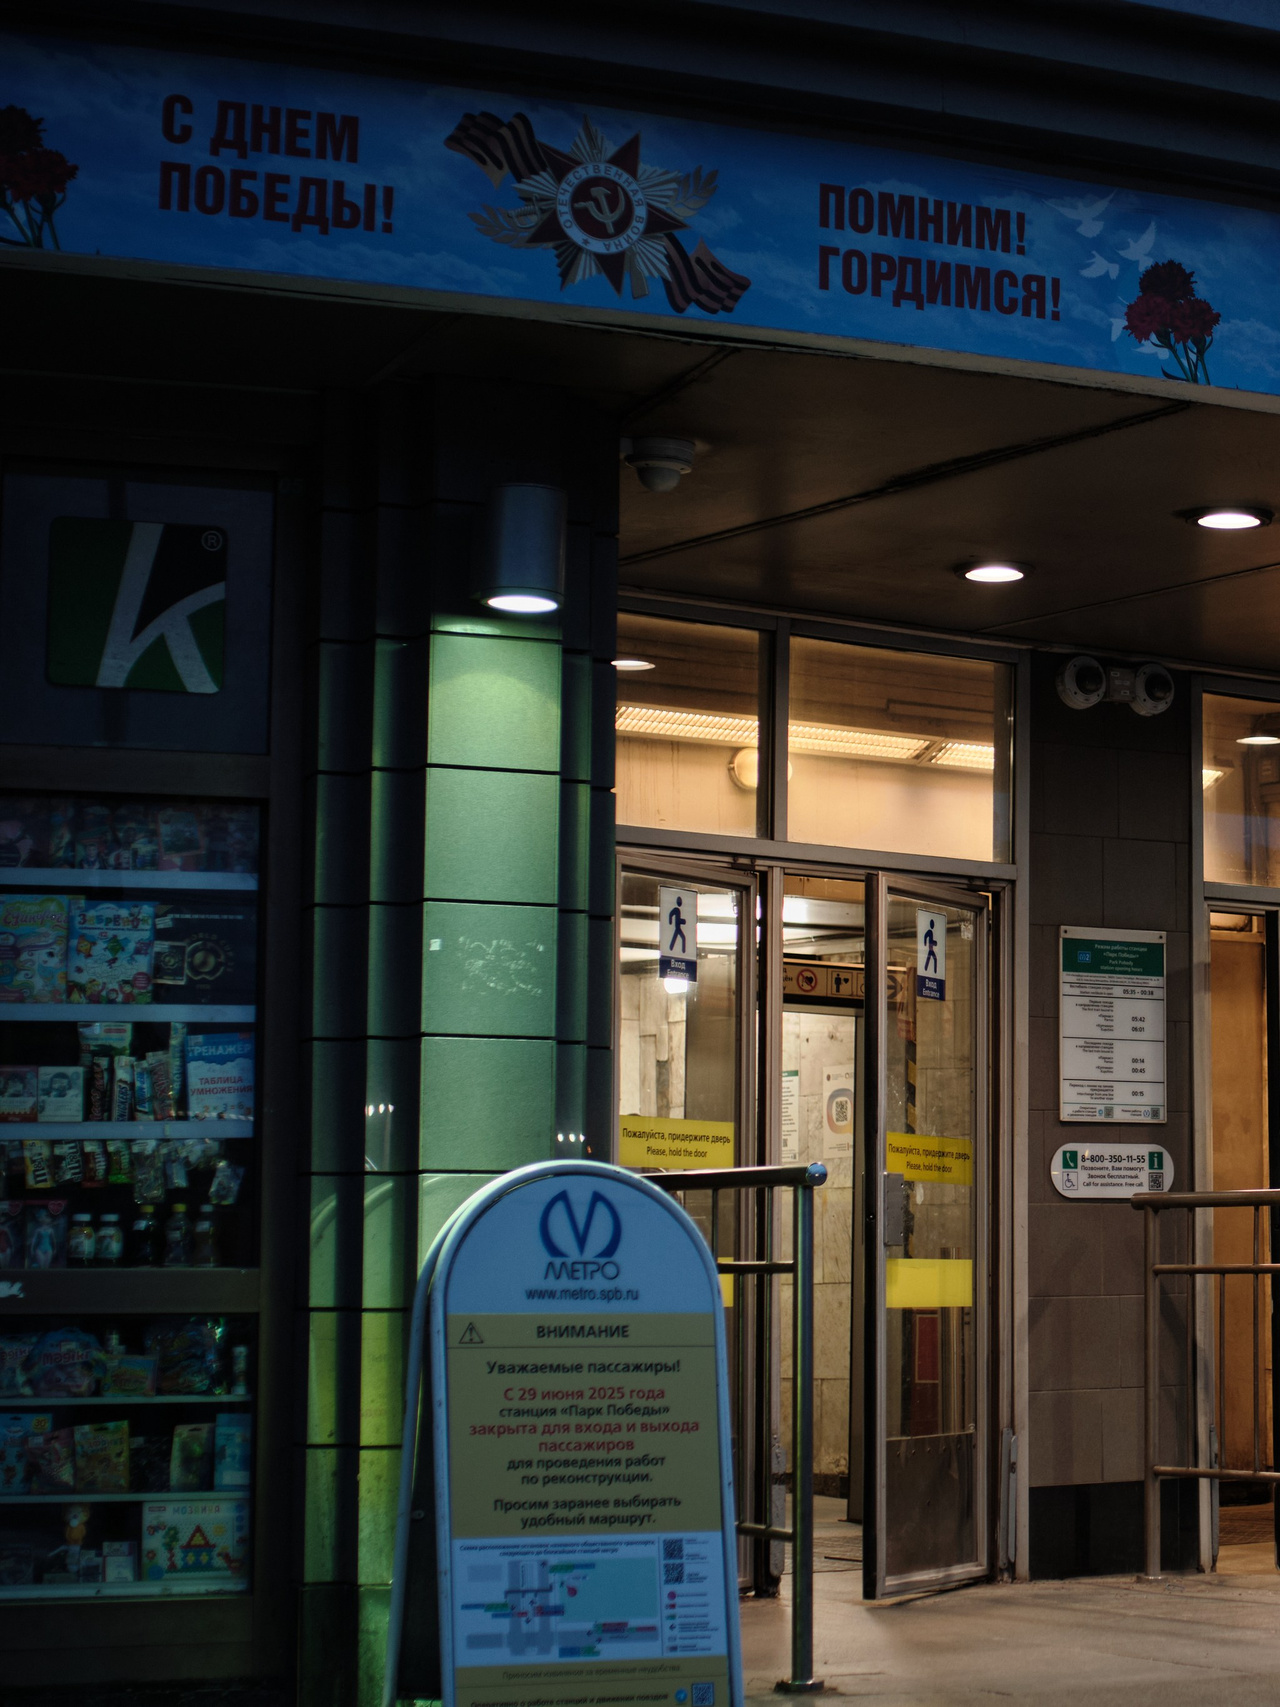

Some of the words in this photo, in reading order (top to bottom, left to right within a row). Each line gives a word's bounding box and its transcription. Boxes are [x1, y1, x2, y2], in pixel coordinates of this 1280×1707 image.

[161, 94, 192, 144] С
[210, 99, 360, 164] ДНЕМ
[159, 160, 395, 235] ПОБЕДЫ!
[558, 164, 644, 229] ОТЕЧЕСТВЕННАЯ
[818, 182, 1026, 256] ПОМНИМ!
[818, 245, 1061, 322] ГОРДИМСЯ!
[925, 979, 938, 989] Вход
[923, 988, 941, 999] Entrance
[622, 1127, 667, 1142] Пожалуйста,
[668, 1132, 710, 1146] придержите
[710, 1134, 731, 1145] дверь
[646, 1146, 667, 1158] Please,
[668, 1147, 682, 1157] hold
[683, 1147, 693, 1157] the
[694, 1147, 707, 1158] door
[888, 1144, 921, 1159] Пожалуйста,
[922, 1148, 955, 1162] придержите
[955, 1152, 971, 1162] дверь
[1081, 1154, 1146, 1163] 8-800-350-11-55
[906, 1161, 922, 1172] Please,
[923, 1161, 933, 1172] hold
[933, 1162, 941, 1172] the
[942, 1163, 953, 1173] door
[544, 1261, 620, 1280] МЕТРО
[525, 1287, 639, 1304] www.metro.spb.ru
[537, 1325, 630, 1339] ВНИМАНИЕ
[486, 1361, 583, 1375] Уважаемые
[588, 1359, 681, 1375] пассажиры!
[504, 1387, 514, 1401] С
[518, 1387, 537, 1401] 29
[541, 1389, 584, 1400] июня
[588, 1386, 625, 1400] 2025
[629, 1388, 665, 1402] года
[499, 1406, 557, 1419] станция
[561, 1404, 603, 1419] «Парк
[607, 1403, 669, 1417] Победы»
[469, 1423, 537, 1438] закрыта
[541, 1423, 570, 1436] для
[574, 1421, 622, 1435] входа
[626, 1421, 637, 1433] и
[640, 1420, 699, 1434] выхода
[538, 1439, 634, 1454] пассажиров
[507, 1459, 533, 1471] для
[537, 1457, 621, 1471] проведения
[625, 1454, 666, 1469] работ
[521, 1474, 538, 1486] по
[542, 1471, 653, 1487] реконструкции.
[494, 1499, 549, 1514] Просим
[552, 1498, 609, 1512] заранее
[613, 1495, 681, 1509] выбирать
[521, 1513, 585, 1529] удобный
[589, 1510, 656, 1526] маршрут.
